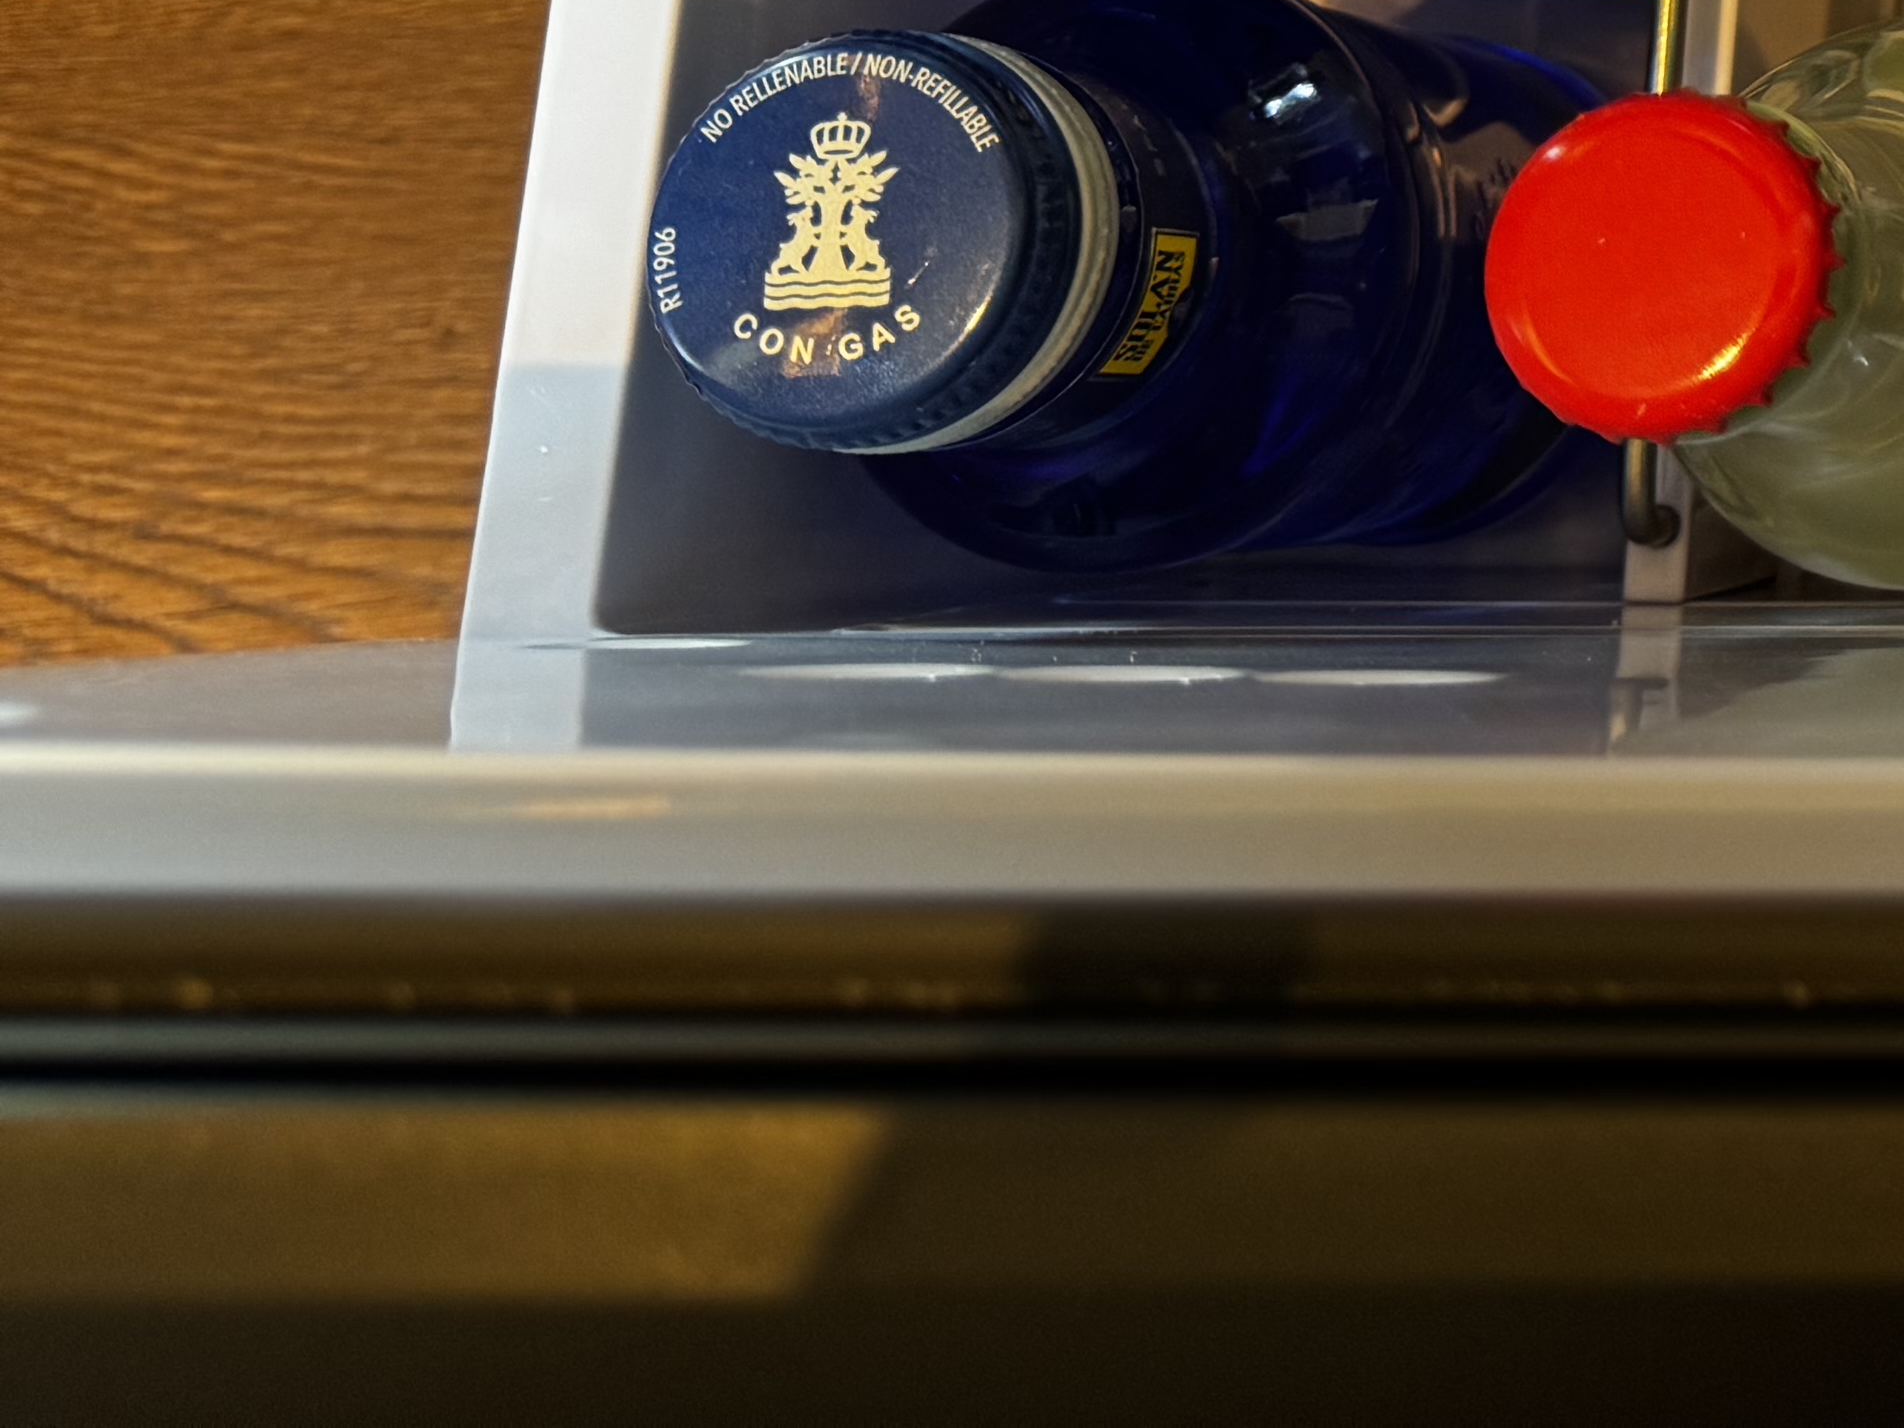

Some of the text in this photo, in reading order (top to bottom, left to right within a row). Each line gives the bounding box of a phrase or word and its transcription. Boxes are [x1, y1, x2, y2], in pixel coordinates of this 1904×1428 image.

[699, 109, 733, 144] NO
[729, 52, 849, 112] RELLENABLE
[863, 52, 999, 153] NON-REFILLABLE
[733, 304, 921, 366] CON GAS
